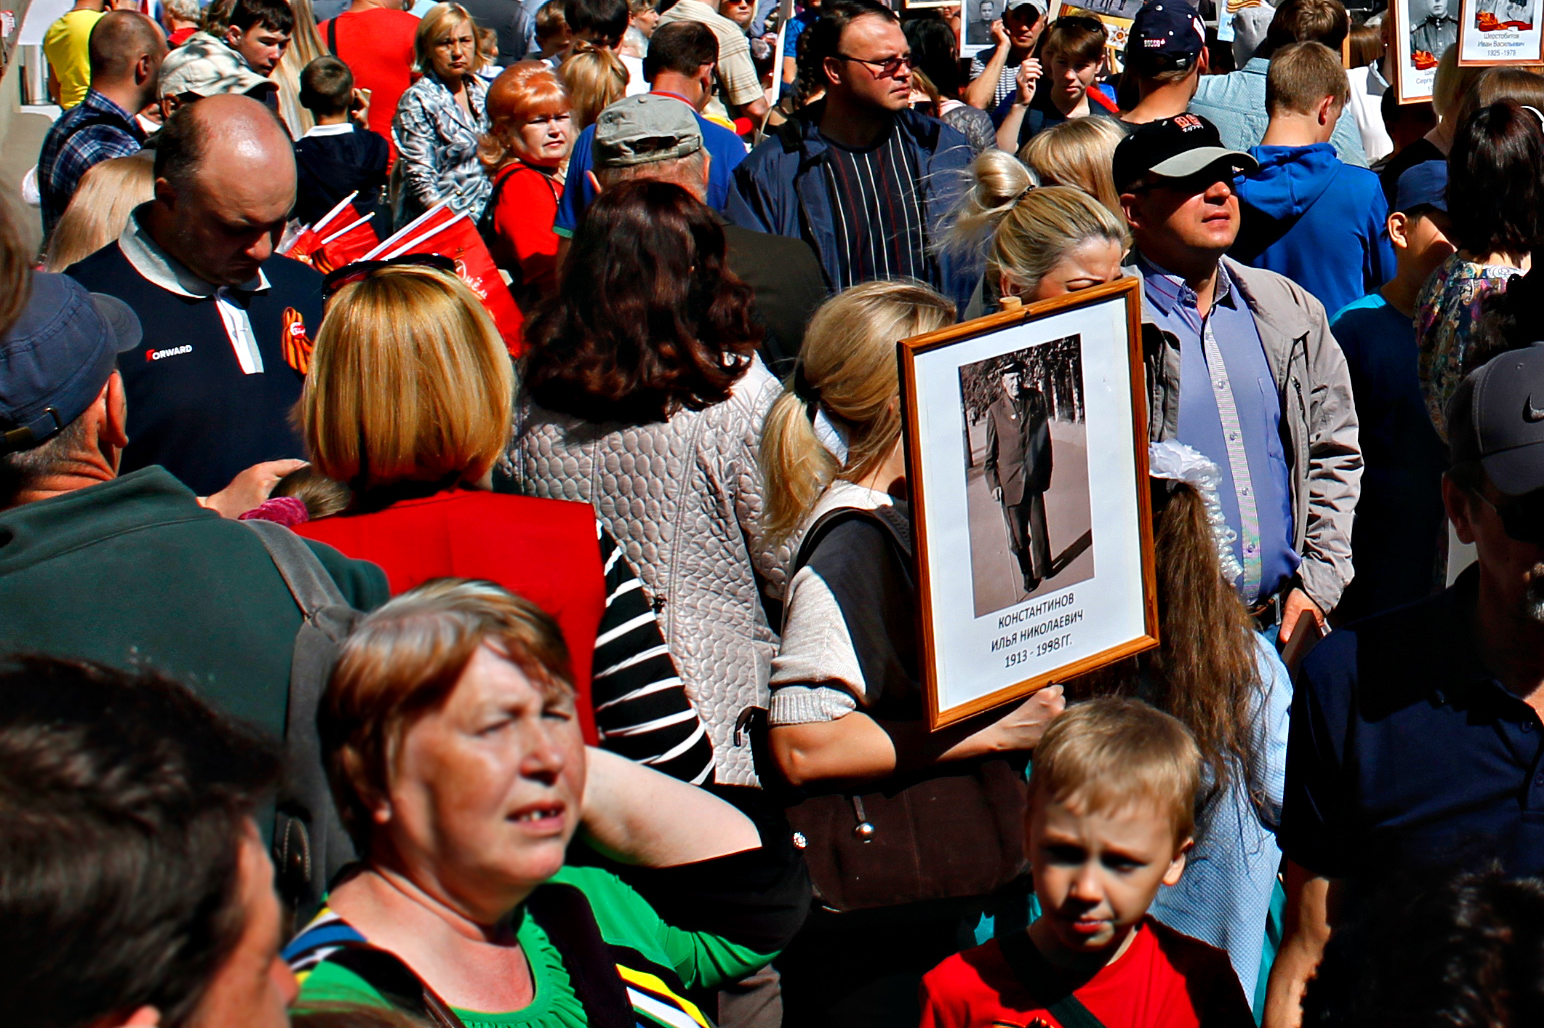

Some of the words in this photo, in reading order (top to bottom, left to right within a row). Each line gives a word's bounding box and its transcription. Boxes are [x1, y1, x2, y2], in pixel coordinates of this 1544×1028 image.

[146, 344, 193, 362] FORWARD
[998, 592, 1075, 630] КОНСТАНТИНОВ
[991, 632, 1018, 653] ИЛЬЯ
[1019, 609, 1084, 643] НИКОЛАЕВИЧ
[1004, 649, 1028, 669] 1913
